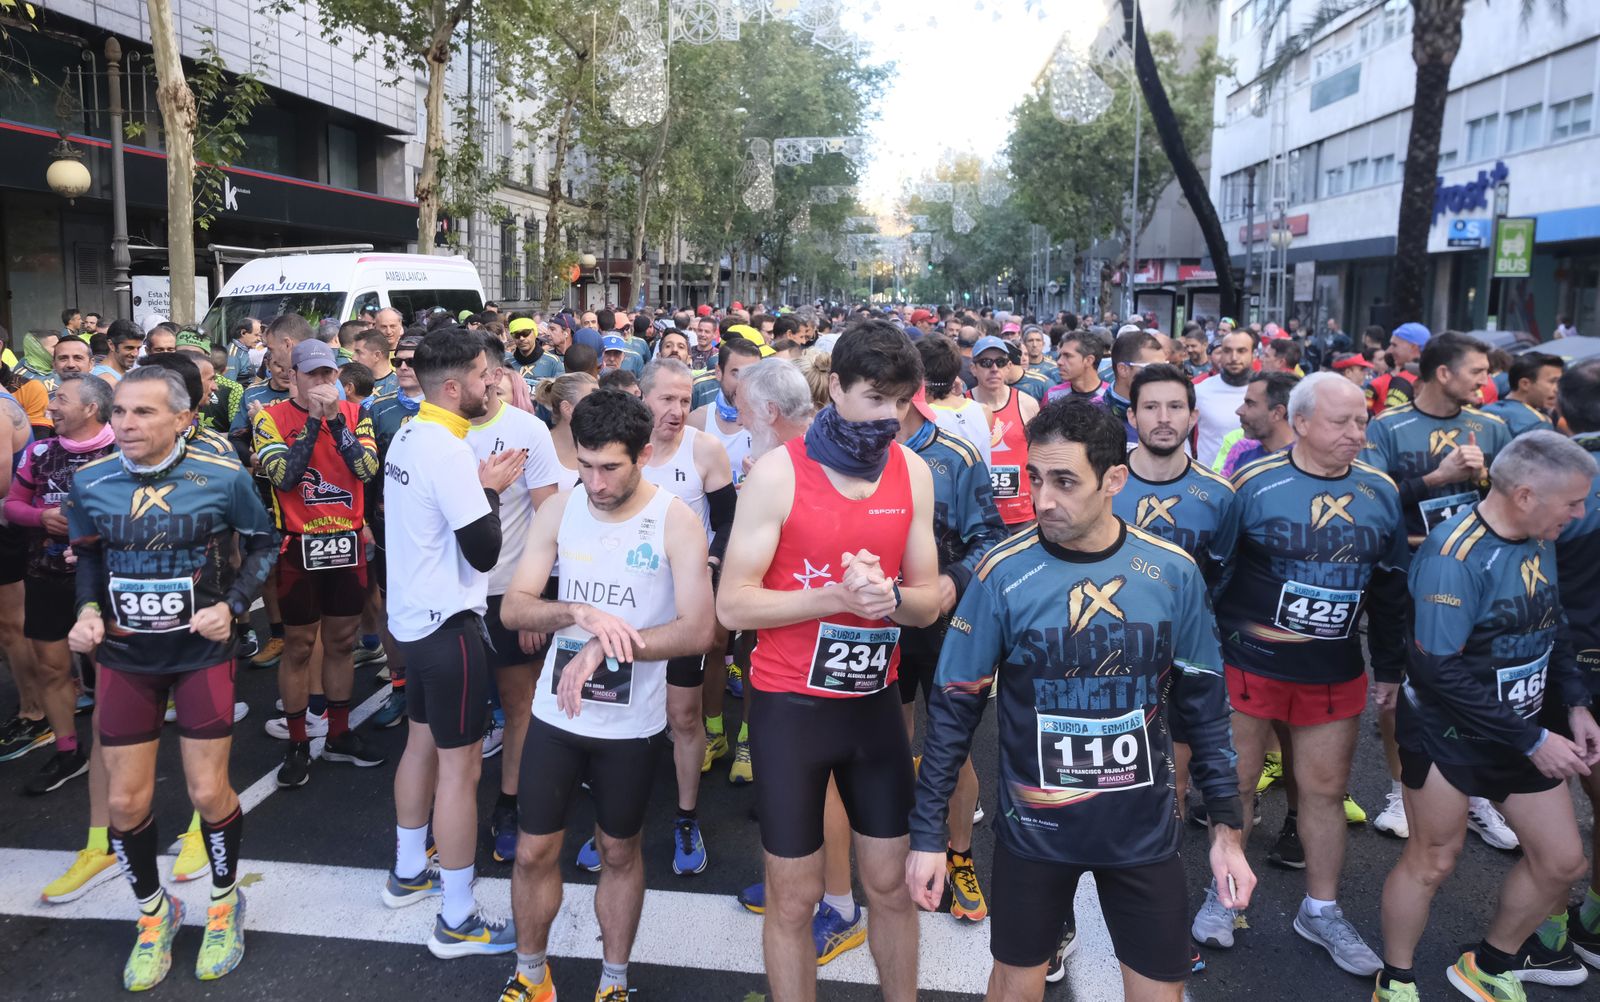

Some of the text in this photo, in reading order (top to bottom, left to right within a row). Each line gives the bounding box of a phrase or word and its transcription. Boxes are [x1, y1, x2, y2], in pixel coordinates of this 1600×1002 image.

[385, 271, 428, 281] AMBULANCIA
[1498, 258, 1527, 271] BUS
[928, 457, 948, 475] SIG
[184, 470, 208, 487] SIG
[131, 482, 178, 522] IX
[1187, 483, 1209, 502] SIG
[1357, 482, 1376, 500] SIG
[1135, 493, 1182, 529] IX
[1309, 491, 1355, 532] IX
[309, 537, 352, 556] 249
[1130, 556, 1161, 581] SIG
[120, 592, 184, 616] 366
[566, 579, 637, 608] INDEA
[1067, 574, 1127, 637] IX
[1287, 597, 1350, 624] 425
[831, 629, 861, 640] SUBIDA
[869, 632, 896, 642] ERMITAS
[824, 642, 887, 672] 234
[1052, 722, 1089, 734] SUBIDA
[1102, 716, 1140, 735] ERMITAS
[1054, 734, 1139, 767] 110
[1106, 773, 1135, 783] IMDECO
[208, 831, 229, 876] WONG
